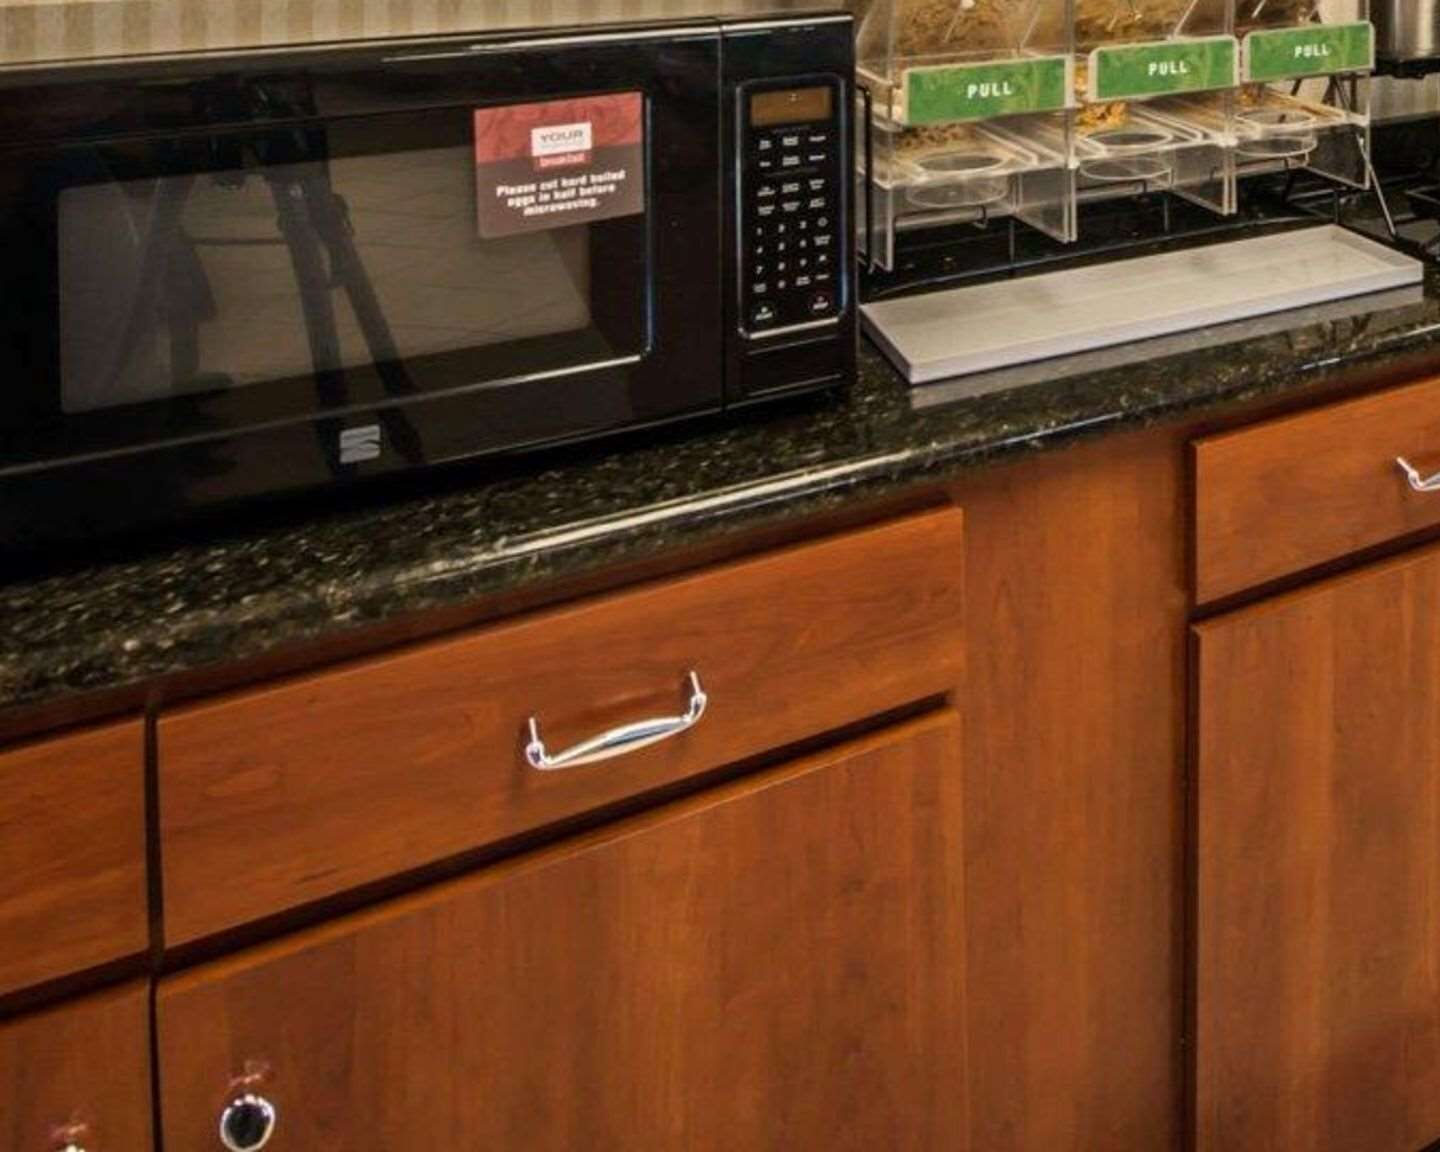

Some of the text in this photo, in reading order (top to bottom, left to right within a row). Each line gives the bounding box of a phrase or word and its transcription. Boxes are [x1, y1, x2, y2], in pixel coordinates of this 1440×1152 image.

[1293, 43, 1332, 59] PULL
[1147, 59, 1189, 77] PULL
[966, 81, 1013, 99] PULL
[541, 129, 585, 143] YOUR
[496, 183, 537, 198] Please
[539, 179, 559, 190] cut
[561, 175, 587, 188] hard
[507, 195, 536, 208] eggs
[553, 187, 576, 200] half
[579, 183, 616, 197] before
